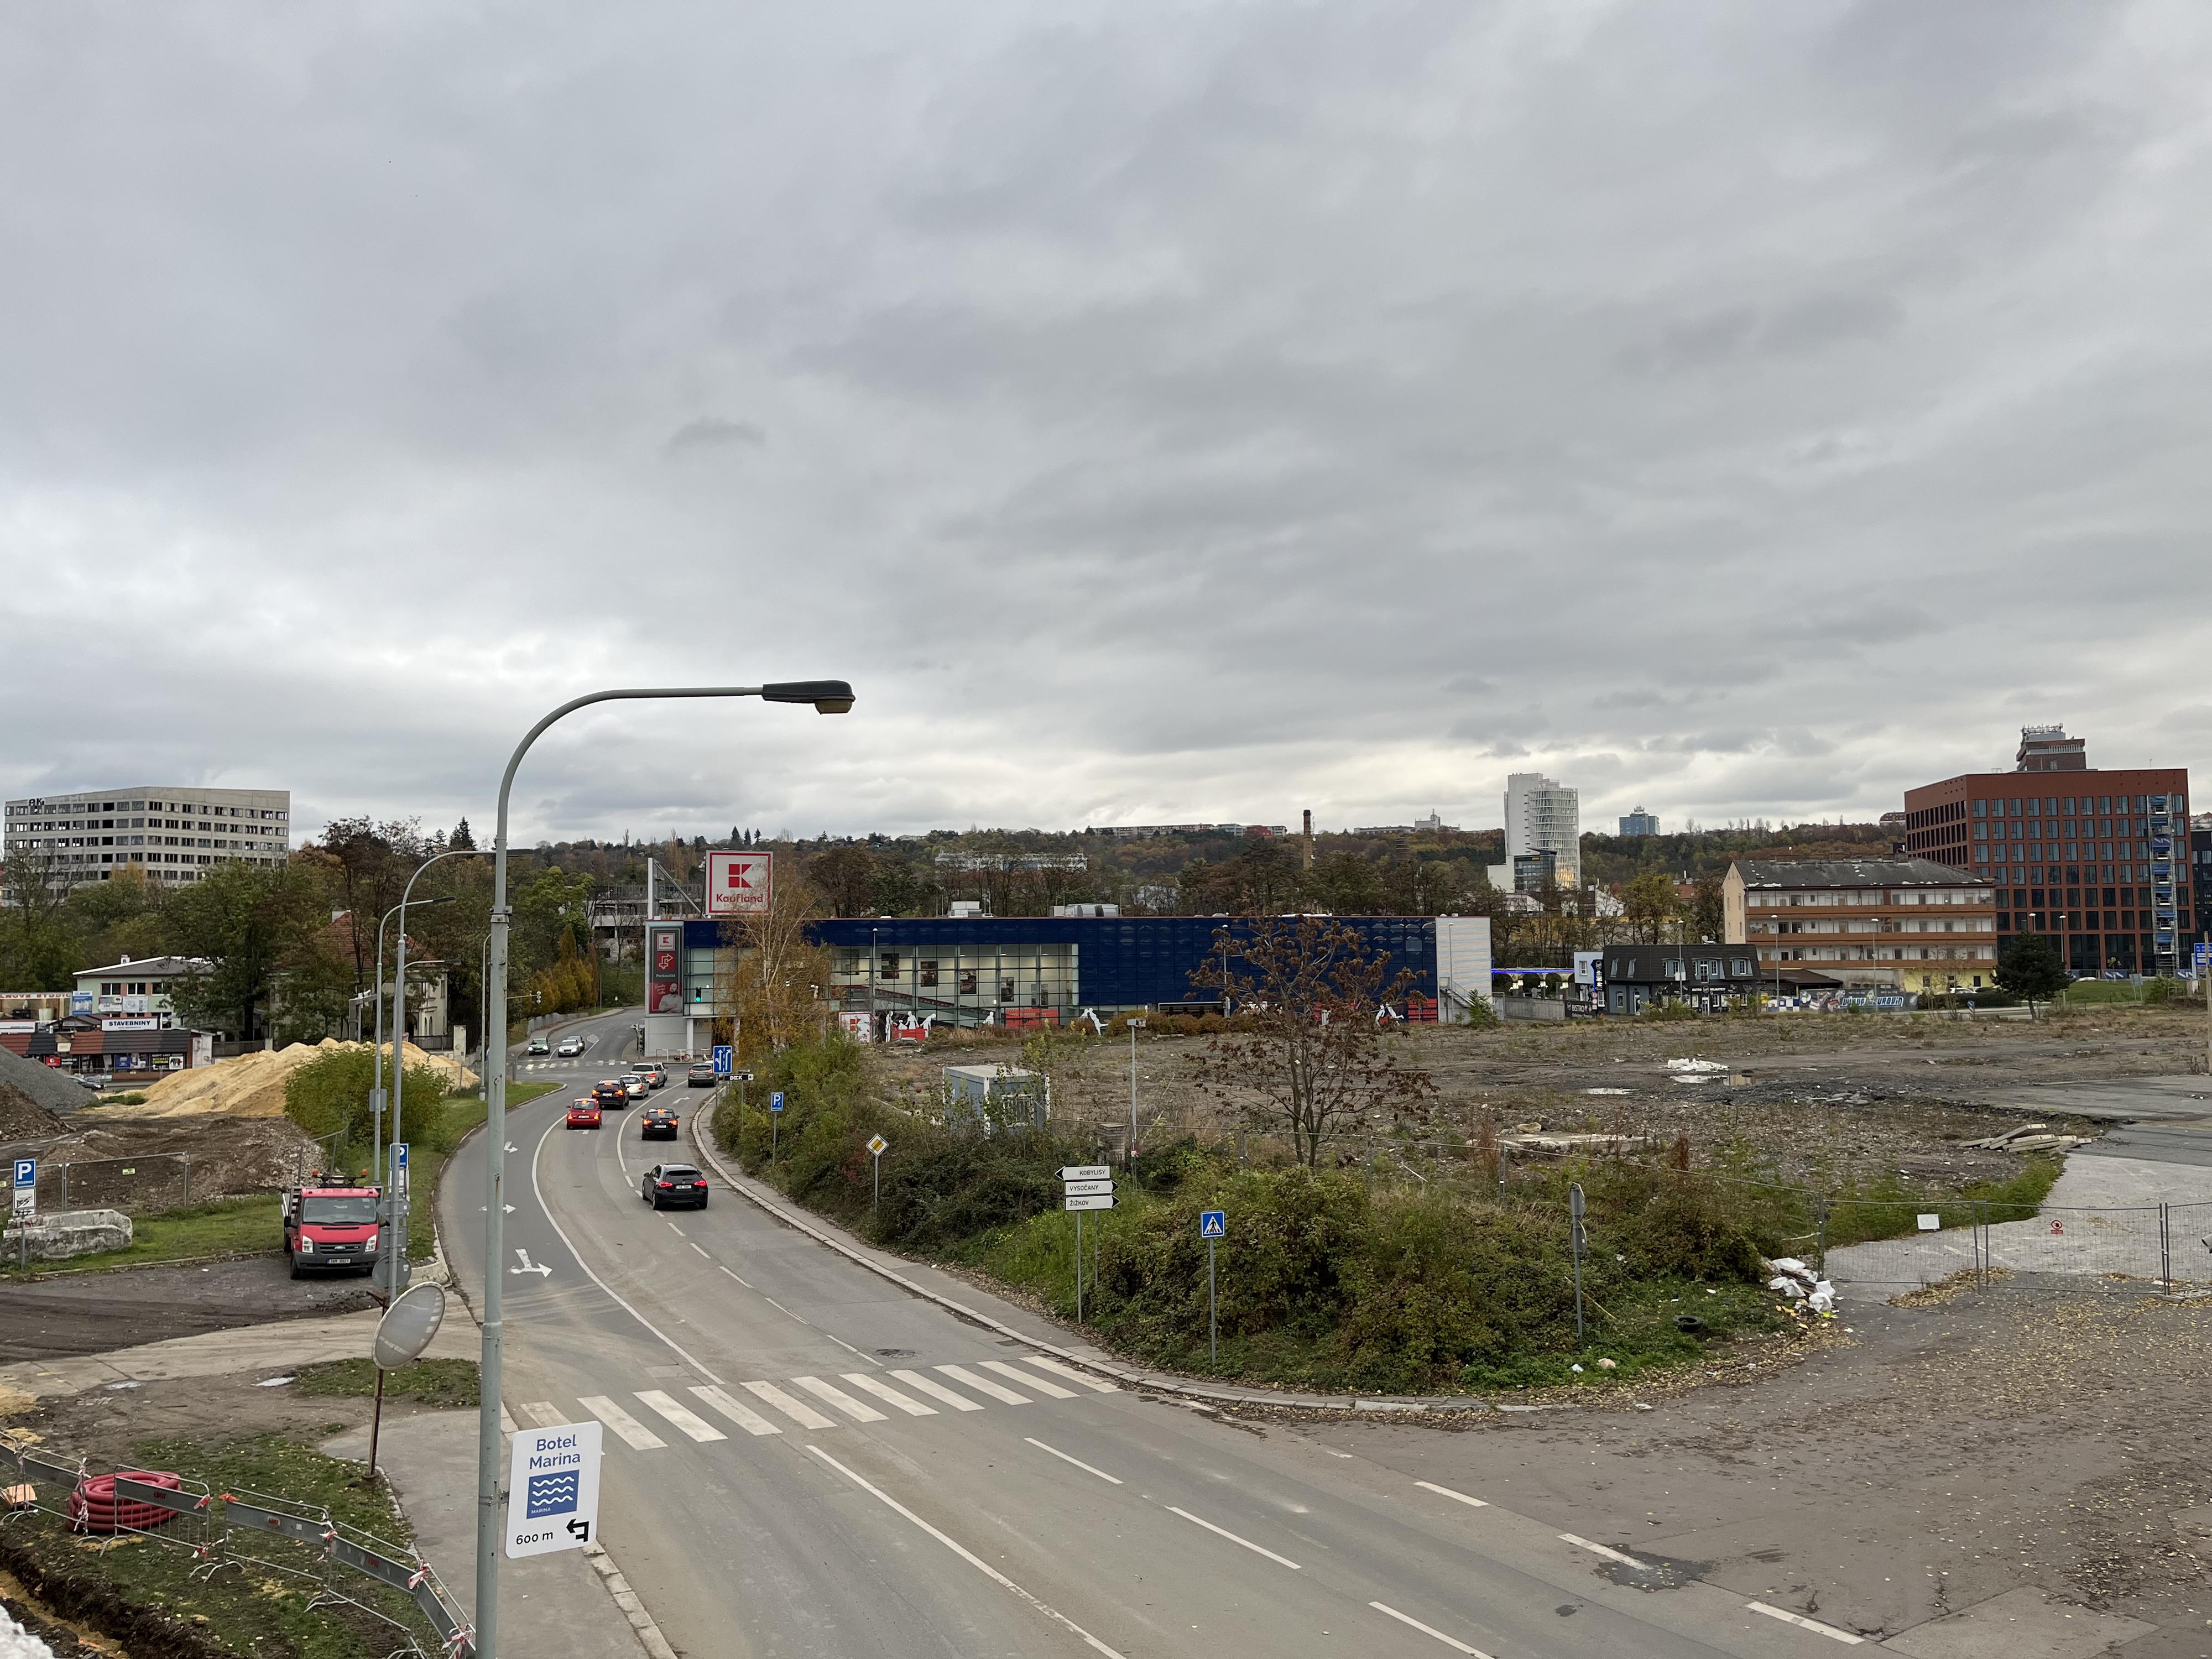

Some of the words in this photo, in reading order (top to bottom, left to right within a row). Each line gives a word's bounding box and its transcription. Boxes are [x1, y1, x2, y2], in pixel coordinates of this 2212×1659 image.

[716, 894, 763, 902] Kaufland
[18, 1162, 32, 1180] P
[536, 1434, 577, 1452] Botel
[529, 1452, 581, 1469] Marina
[516, 1533, 539, 1545] 600
[542, 1531, 554, 1541] m
